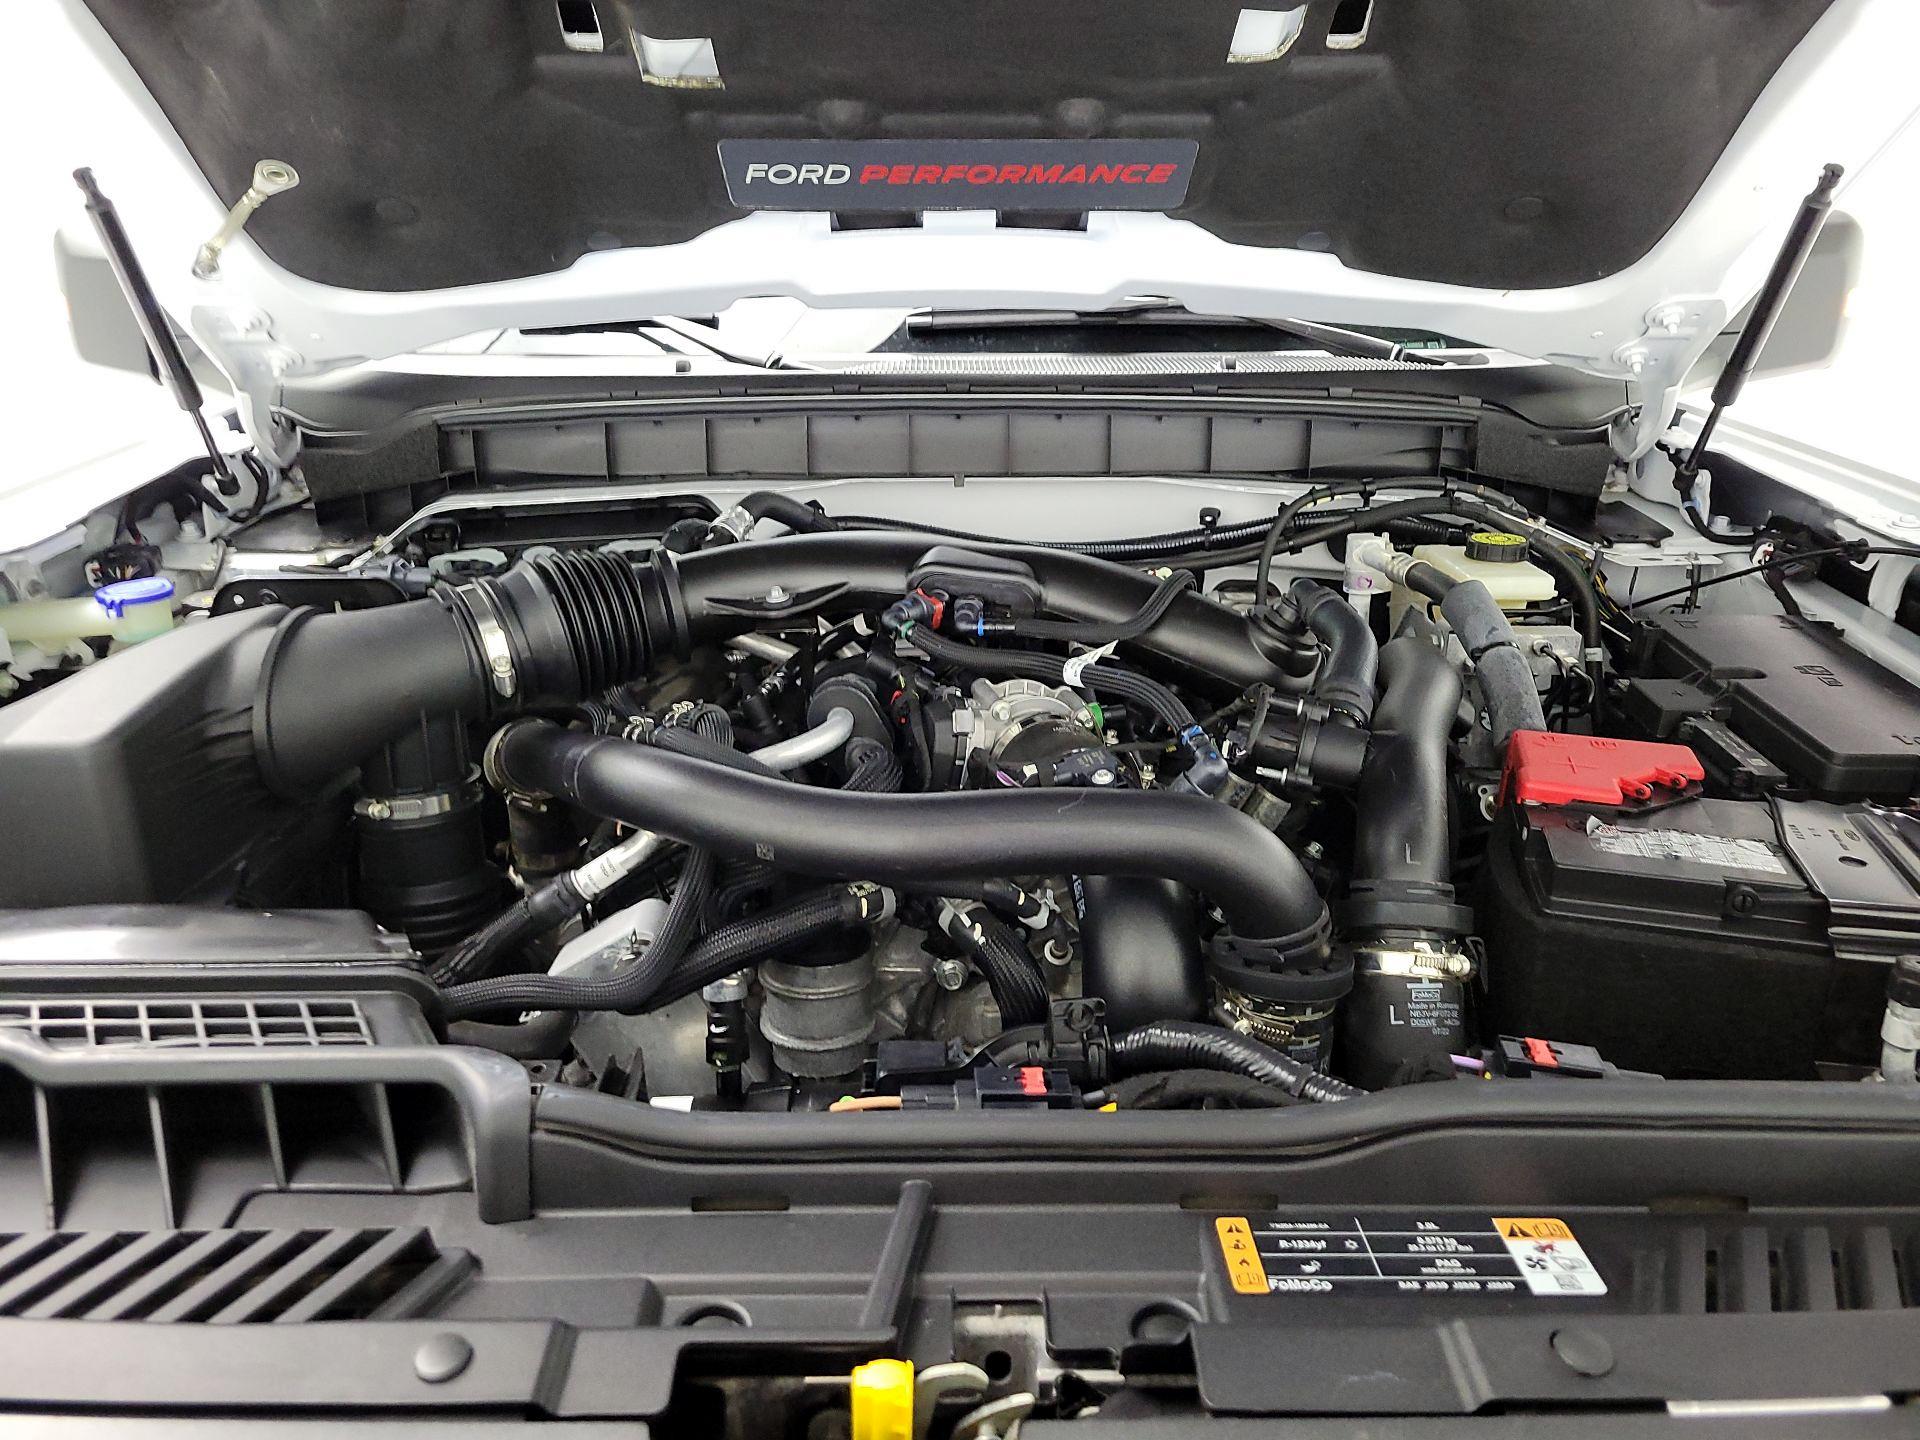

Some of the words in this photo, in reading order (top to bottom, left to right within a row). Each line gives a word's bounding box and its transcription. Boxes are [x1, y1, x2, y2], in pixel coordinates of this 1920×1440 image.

[745, 163, 850, 184] FORD
[859, 164, 1175, 184] PERFORMANCE
[1406, 843, 1420, 865] L
[1389, 1005, 1404, 1024] L
[1279, 1240, 1326, 1250] R-1234yf
[1269, 1279, 1333, 1291] FoMoCo
